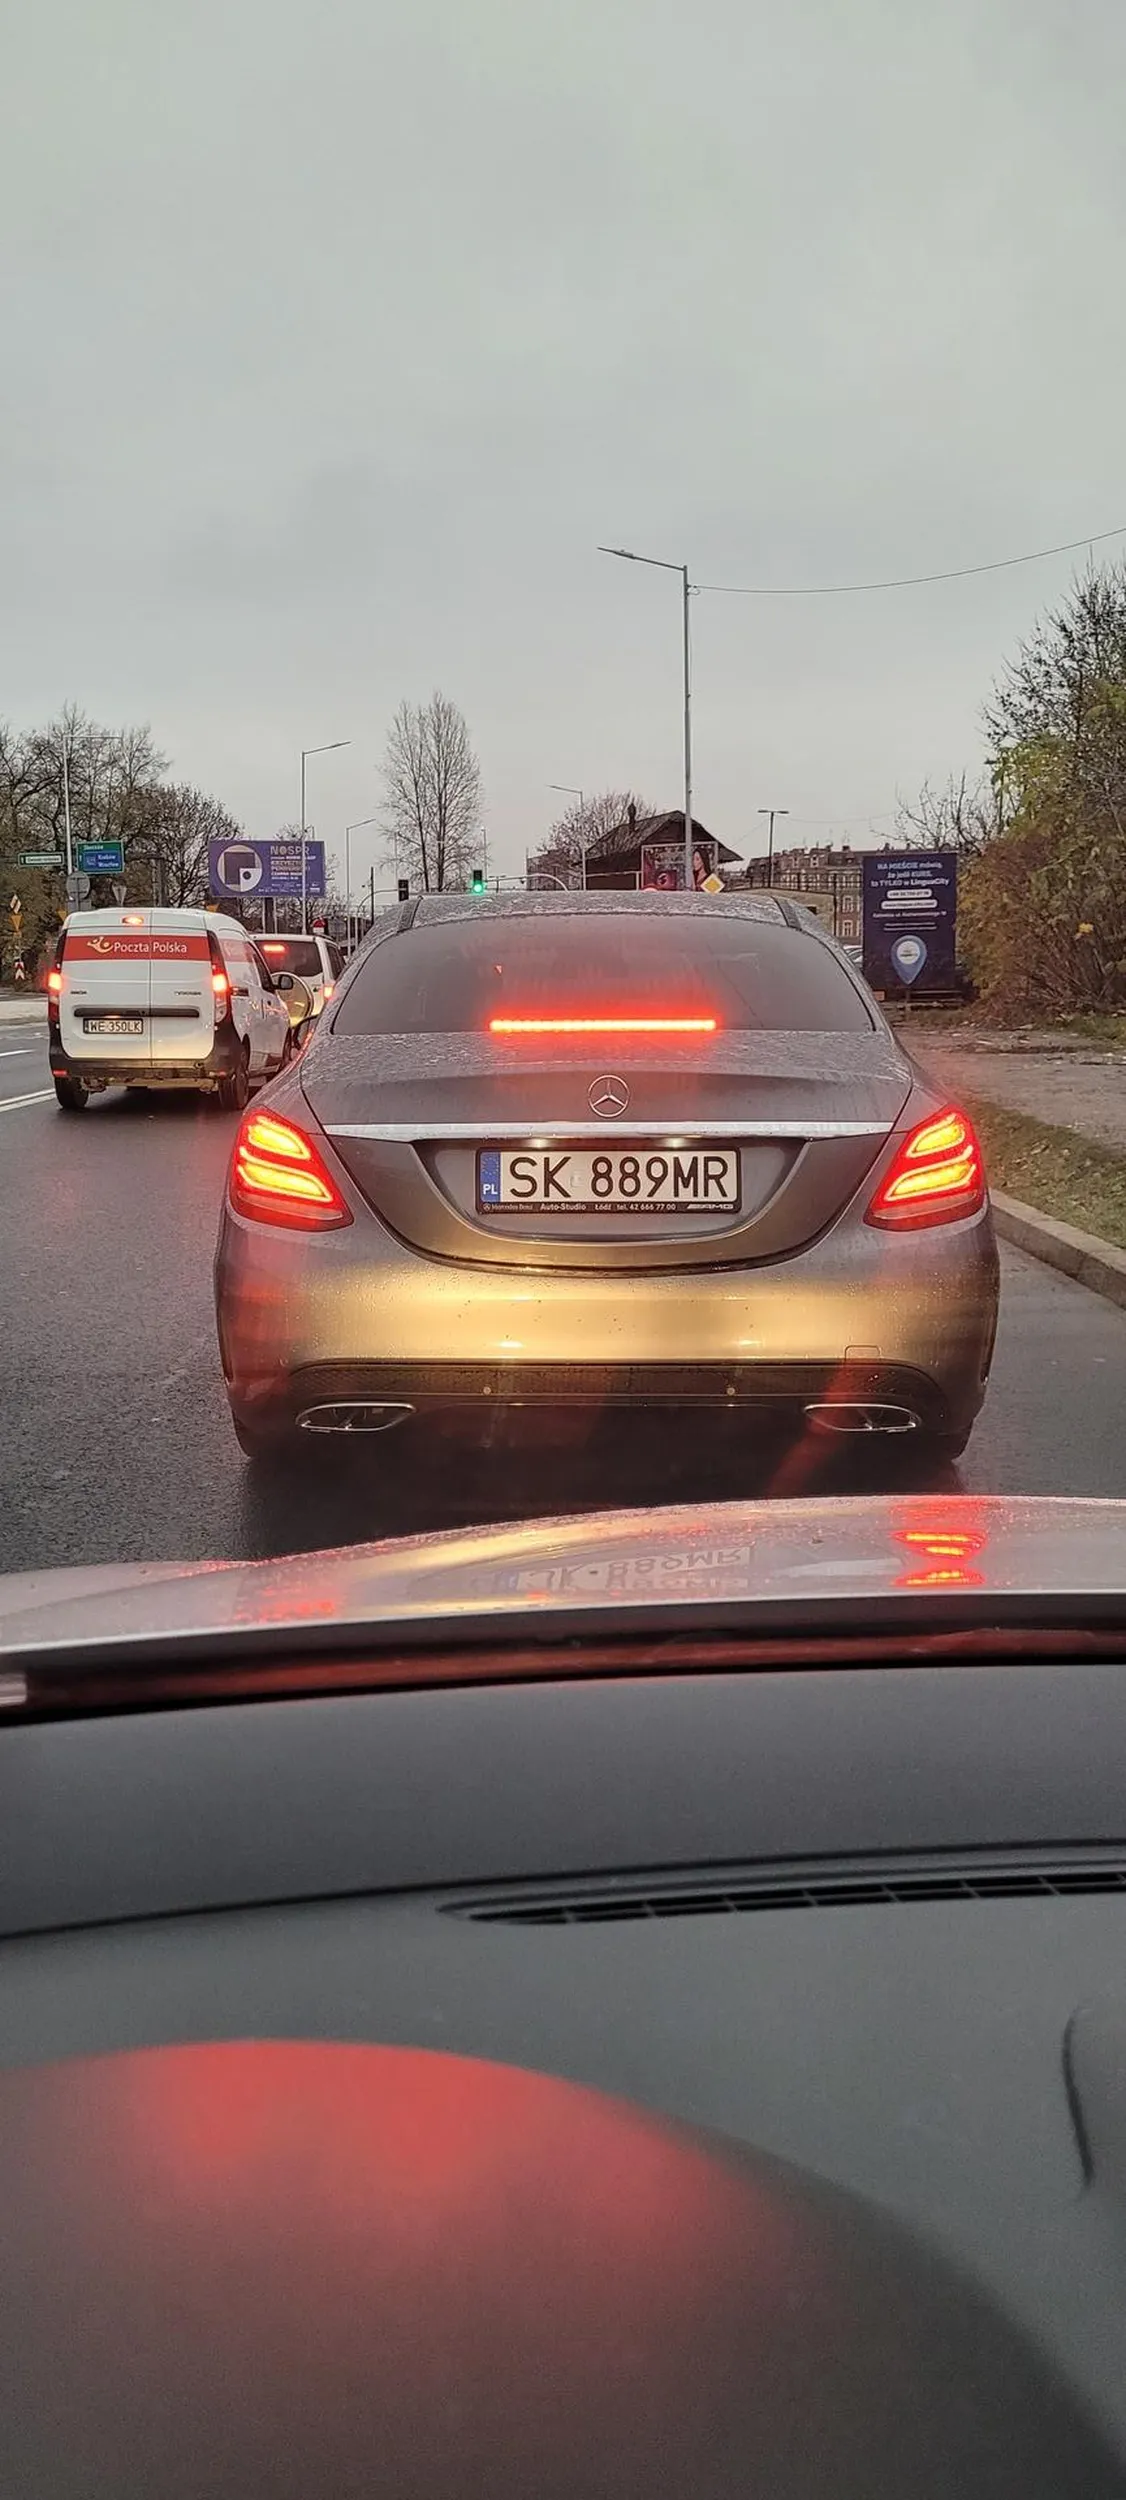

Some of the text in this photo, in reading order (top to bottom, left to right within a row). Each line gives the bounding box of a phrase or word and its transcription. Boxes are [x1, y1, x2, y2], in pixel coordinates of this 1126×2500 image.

[270, 845, 310, 855] NOSPR
[113, 941, 187, 953] Poczta Polska
[90, 1021, 141, 1032] WE 350LK
[509, 1156, 729, 1198] SK 889MR
[482, 1184, 498, 1196] PL
[539, 1203, 587, 1211] Auto-Studio
[594, 1203, 612, 1211] Łódź
[629, 1203, 639, 1211] 42
[640, 1203, 654, 1211] 666
[655, 1203, 665, 1211] 77
[666, 1203, 677, 1211] 00
